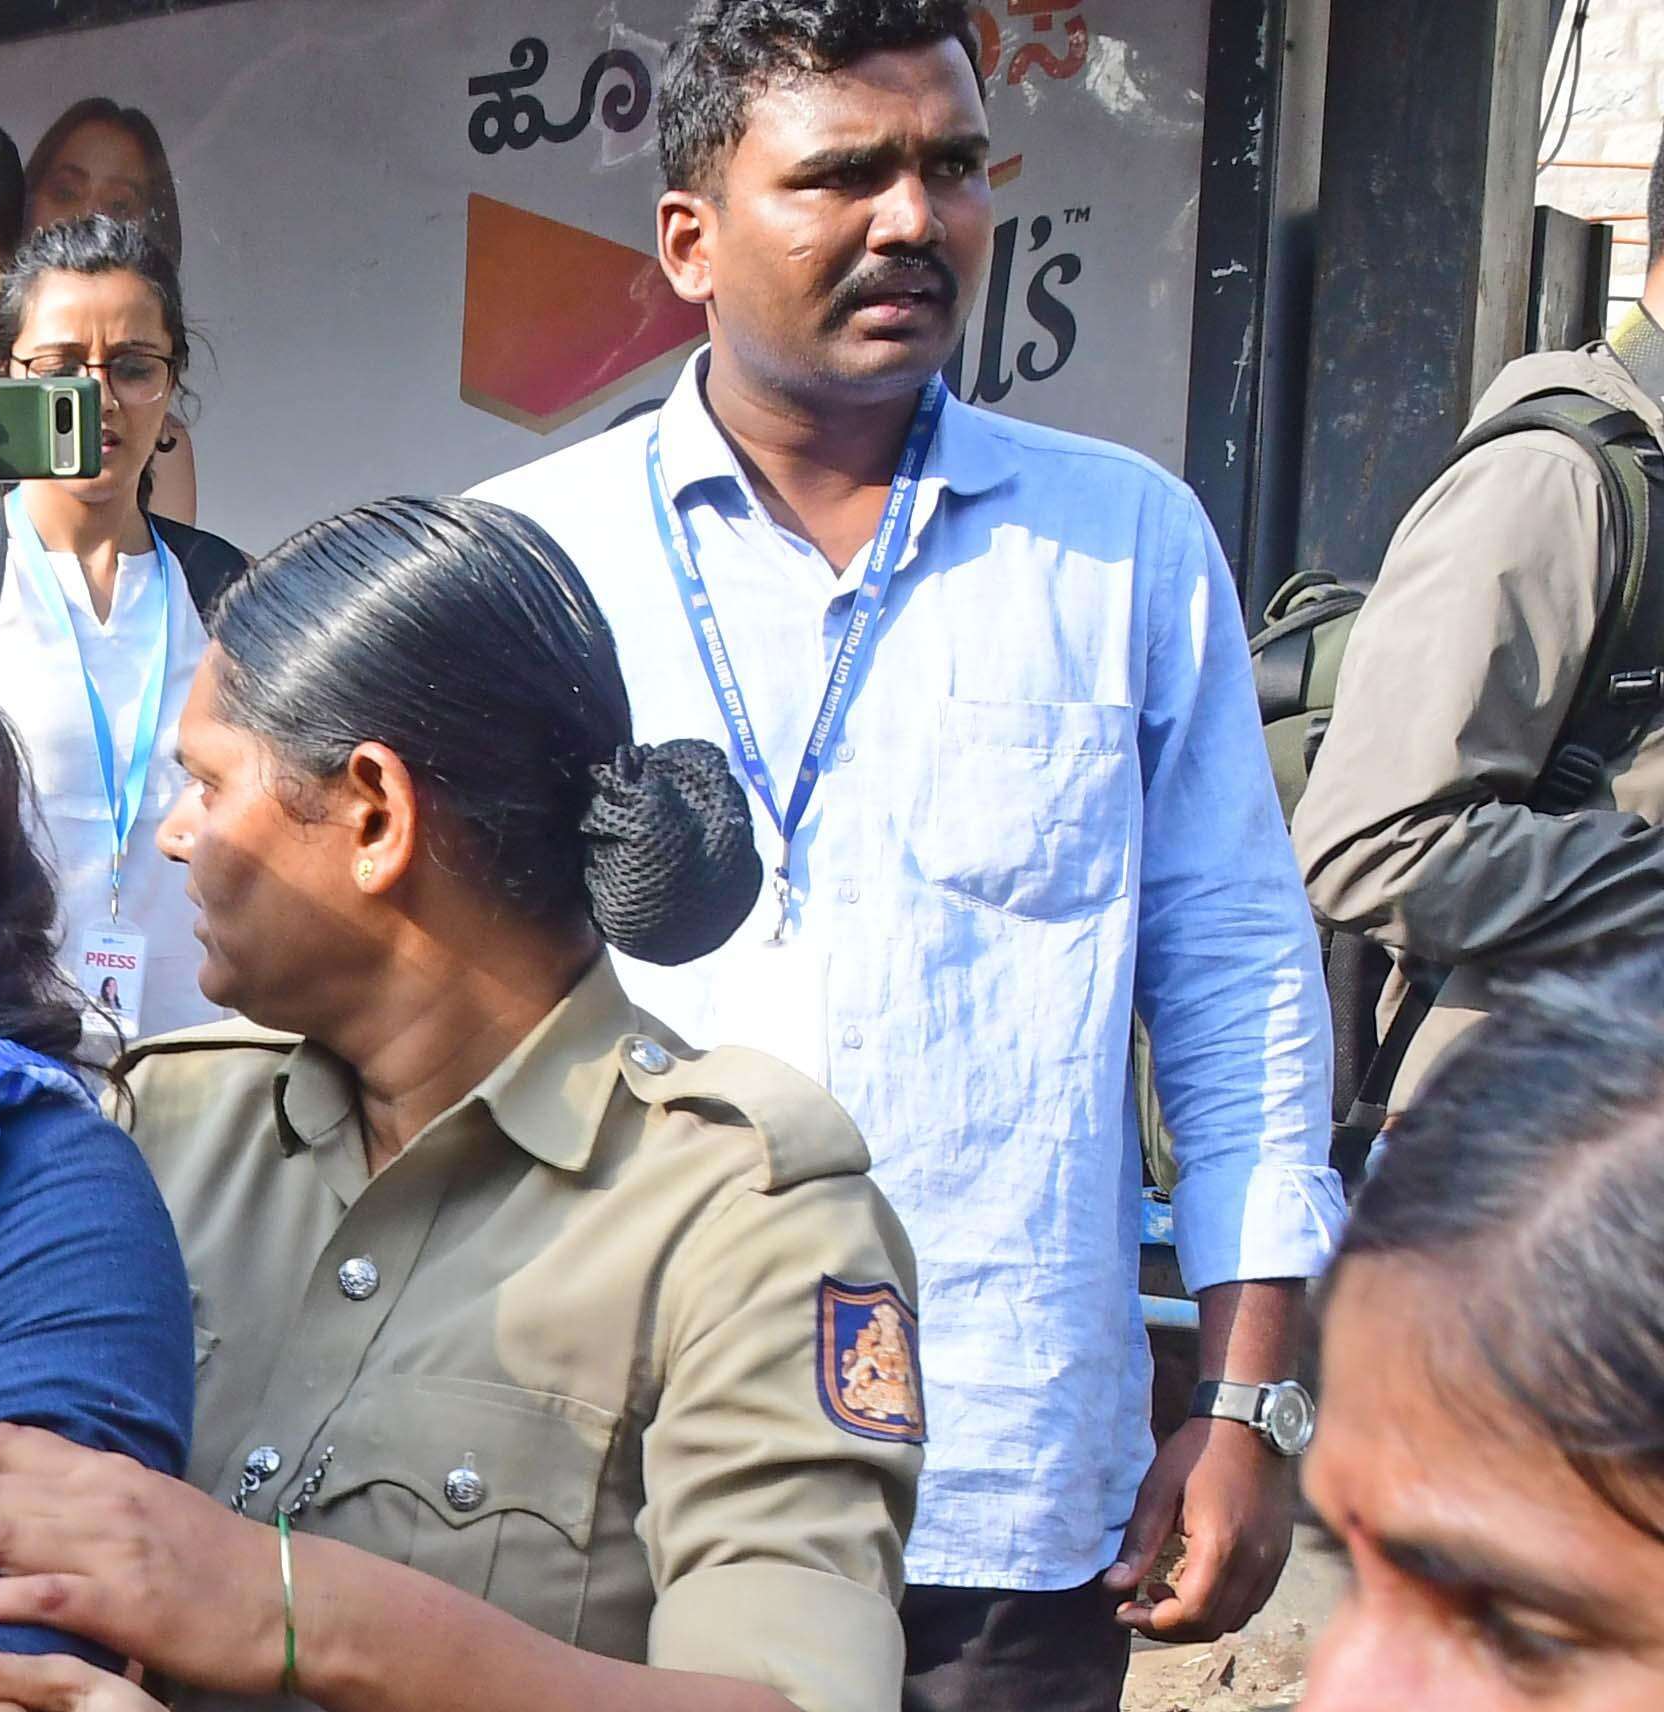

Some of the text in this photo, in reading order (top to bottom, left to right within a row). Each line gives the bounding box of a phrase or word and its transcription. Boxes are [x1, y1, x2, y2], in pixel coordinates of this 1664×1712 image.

[700, 616, 758, 763] BENGALURU CITY POLICE
[808, 608, 870, 758] BENGALURU CITY POLICE
[85, 951, 137, 970] PRESS
